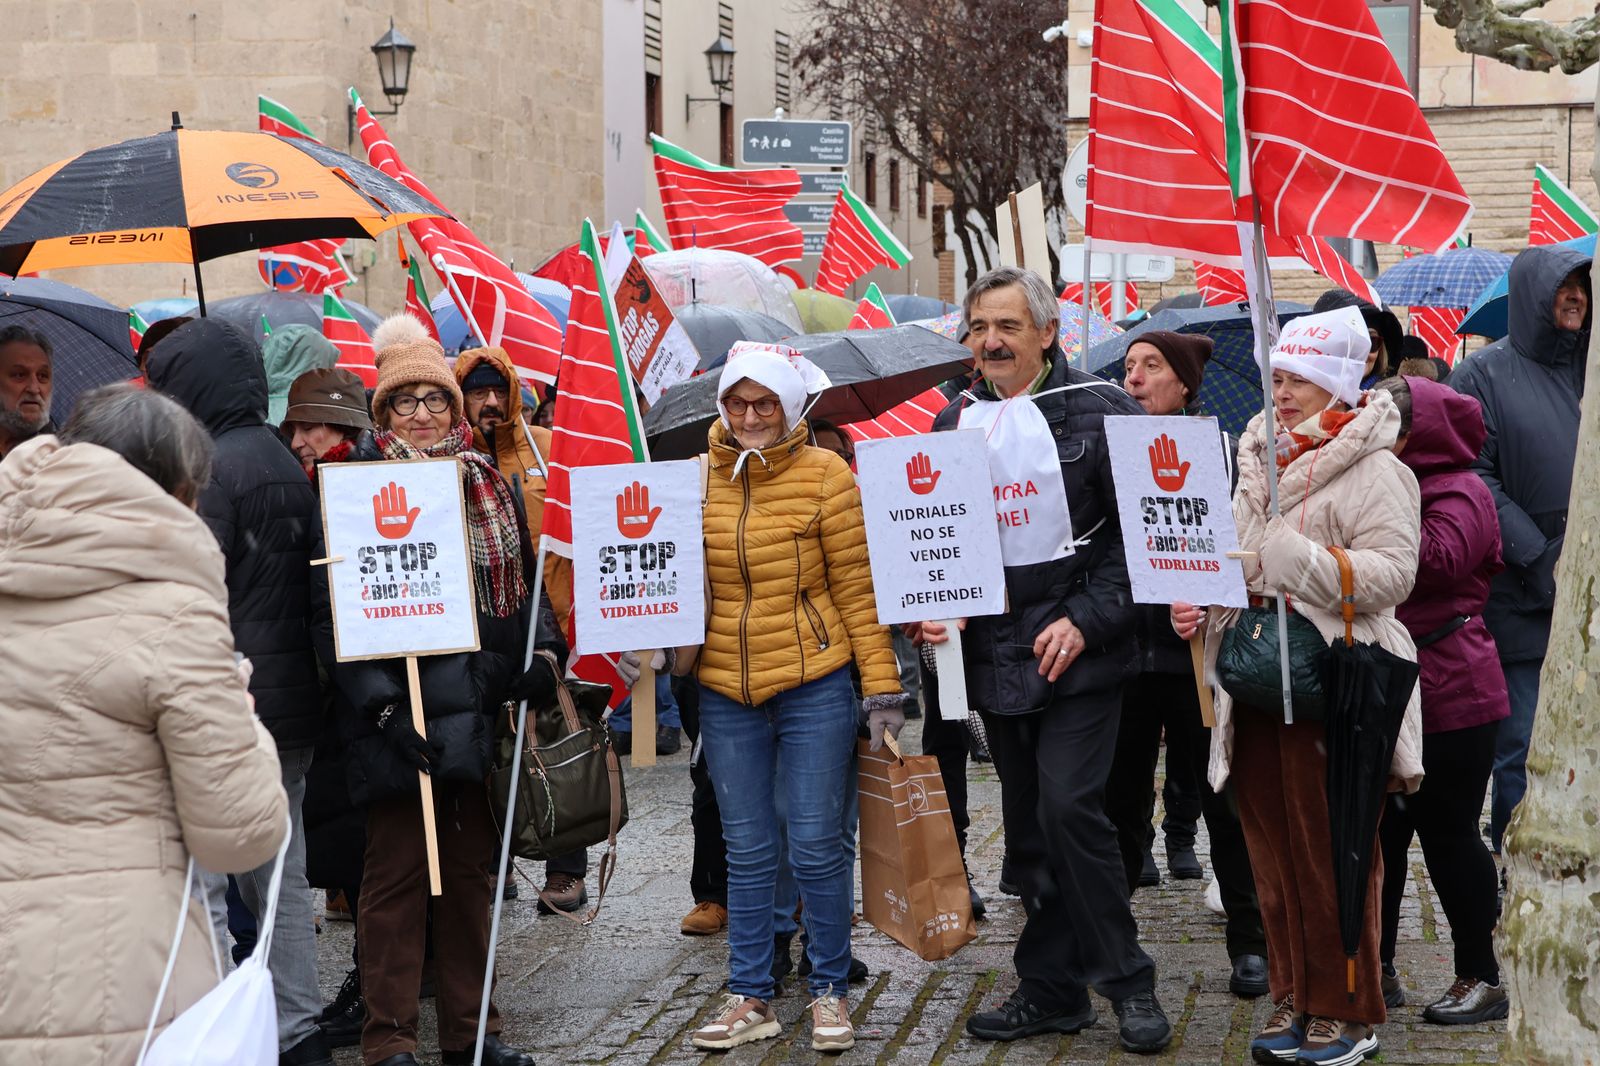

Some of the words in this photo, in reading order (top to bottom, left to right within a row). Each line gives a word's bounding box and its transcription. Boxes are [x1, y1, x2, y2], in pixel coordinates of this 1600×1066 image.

[217, 190, 319, 204] INESIS
[628, 311, 659, 371] BIOGÁS
[662, 351, 673, 370] CALLA
[889, 503, 967, 522] VIDRIALES
[1140, 496, 1209, 526] STOP
[911, 527, 934, 541] NO
[939, 526, 956, 538] SE
[358, 542, 437, 574] STOP
[599, 541, 675, 574] STOP
[910, 546, 961, 562] VENDE
[1149, 558, 1220, 572] VIDRIALES
[928, 569, 945, 582] SE
[901, 586, 983, 609] ¡DEFIENDE!
[363, 602, 445, 620] VIDRIALES
[600, 602, 679, 619] VIDRIALES
